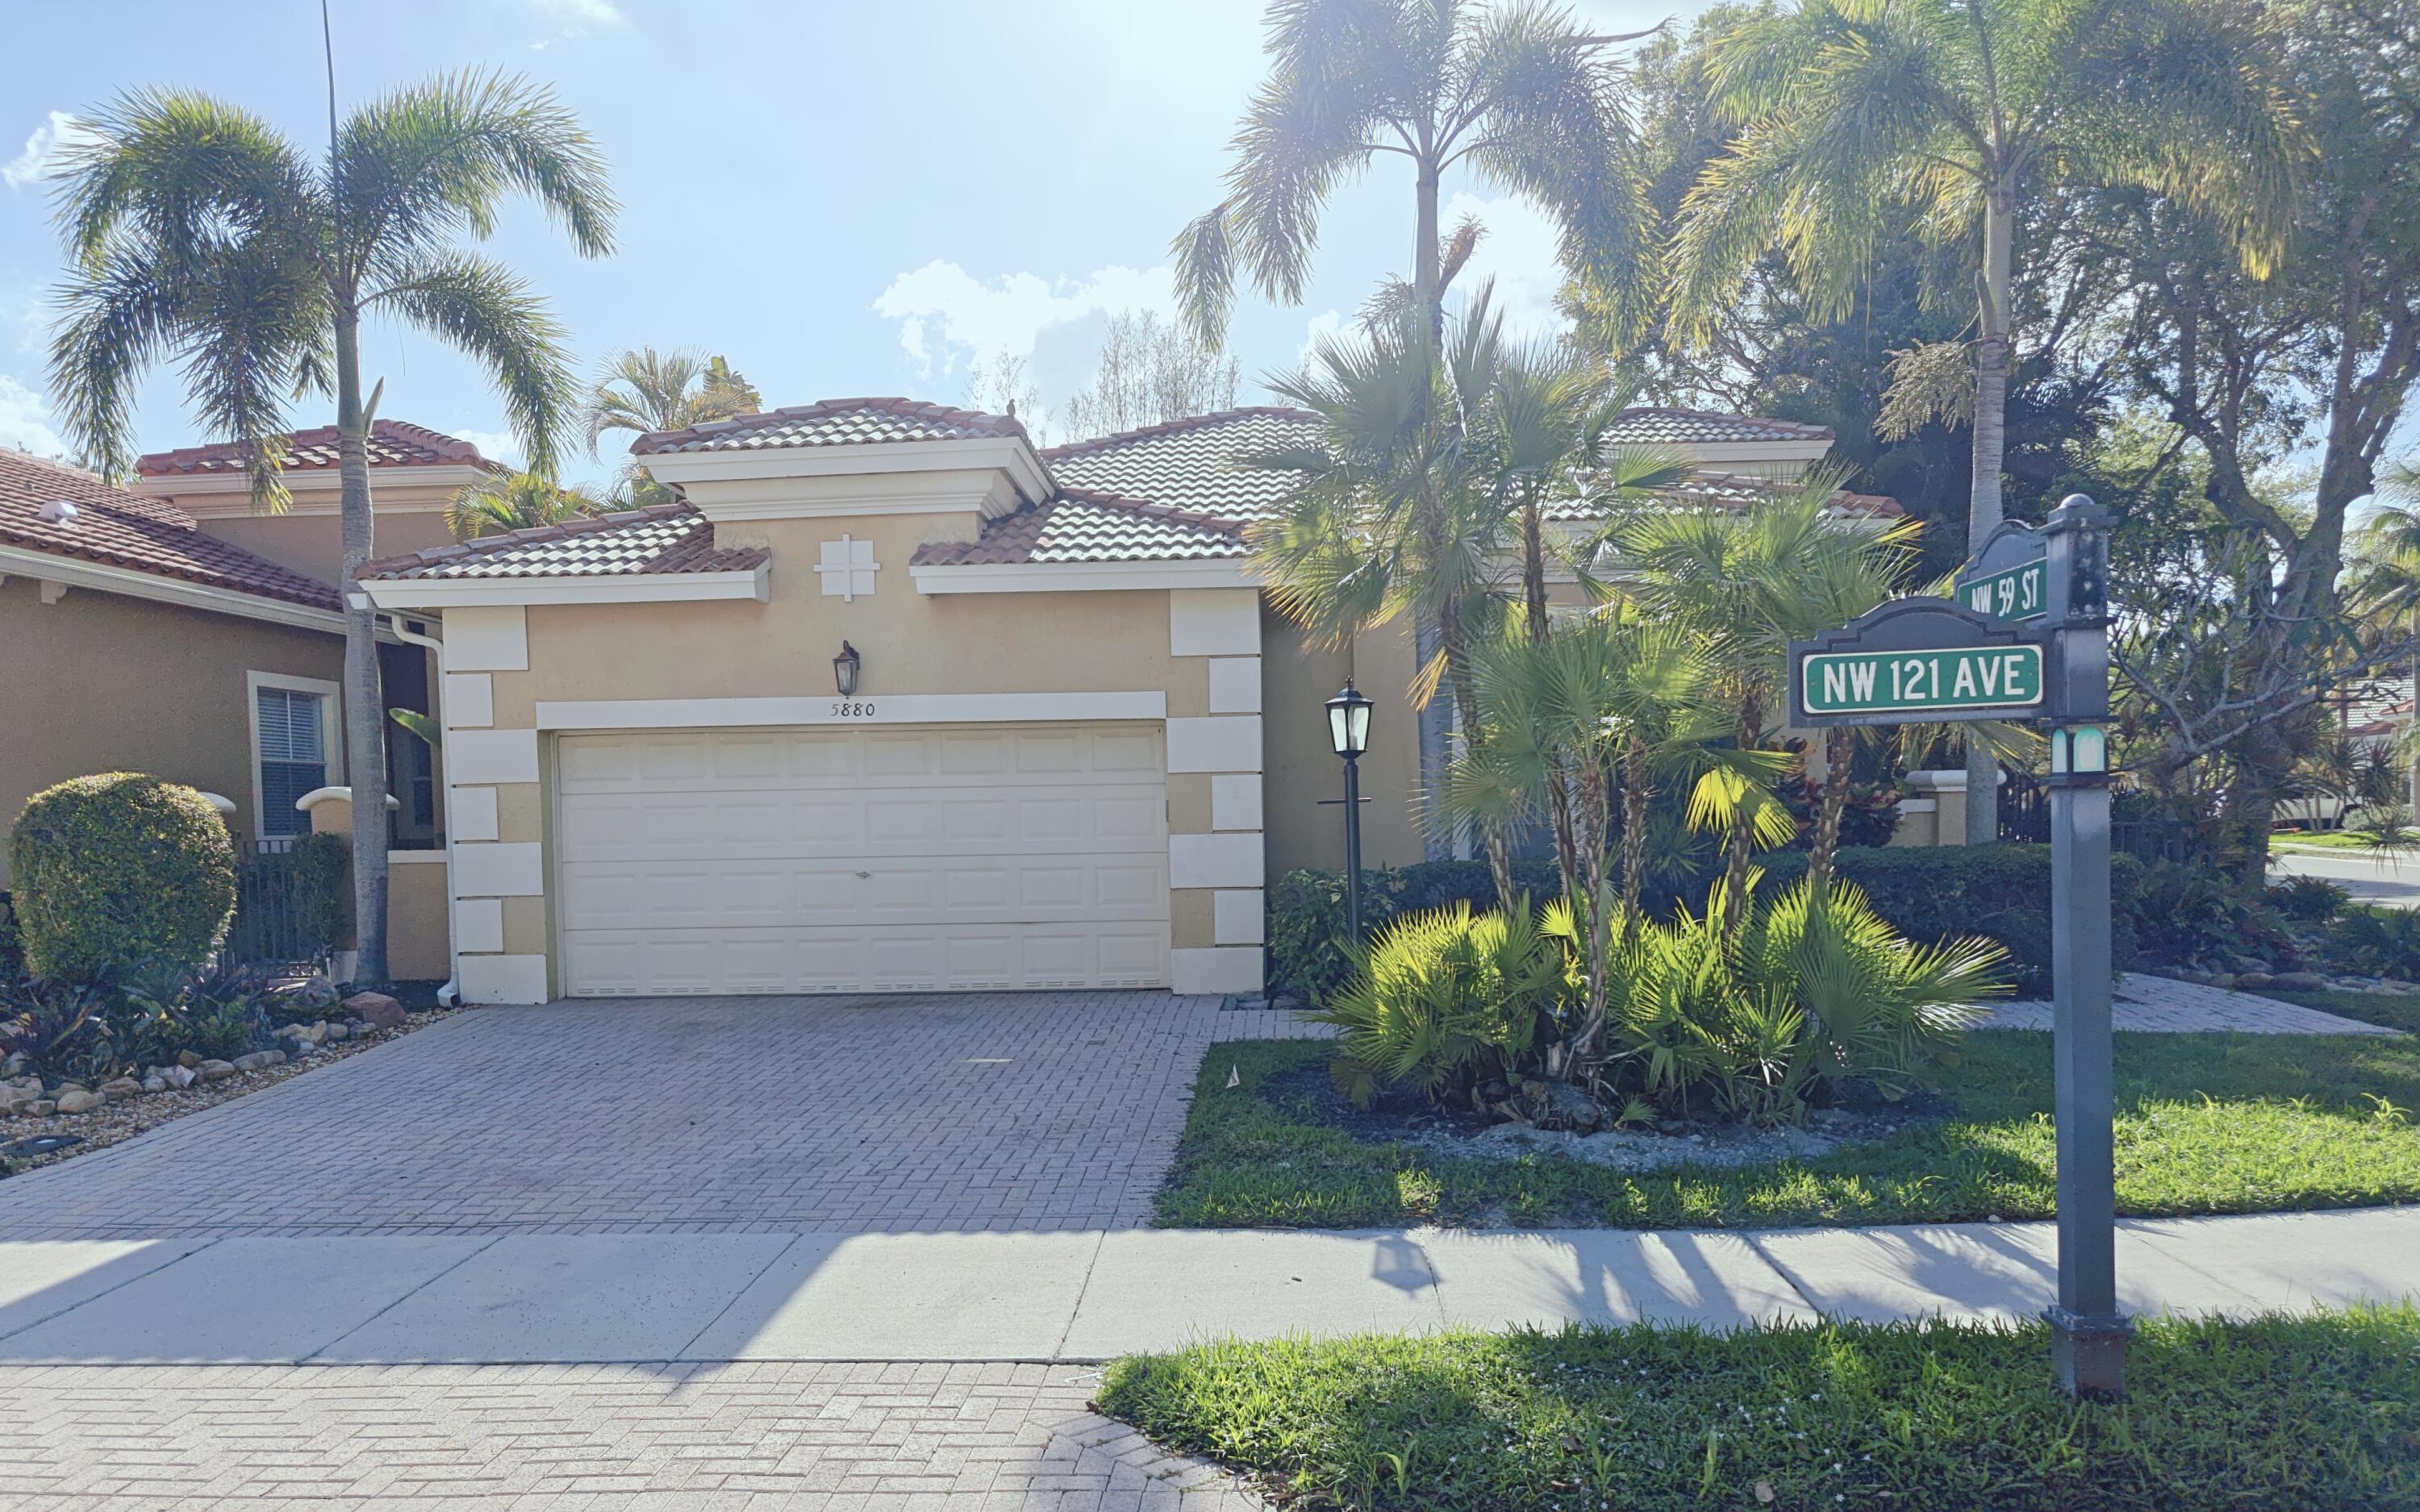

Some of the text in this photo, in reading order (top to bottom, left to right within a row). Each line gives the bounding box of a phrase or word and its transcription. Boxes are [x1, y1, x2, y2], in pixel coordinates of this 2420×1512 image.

[1971, 569, 2039, 617] NW 59 ST
[1823, 655, 2026, 704] NW 121 AVE
[829, 702, 875, 717] 5880
